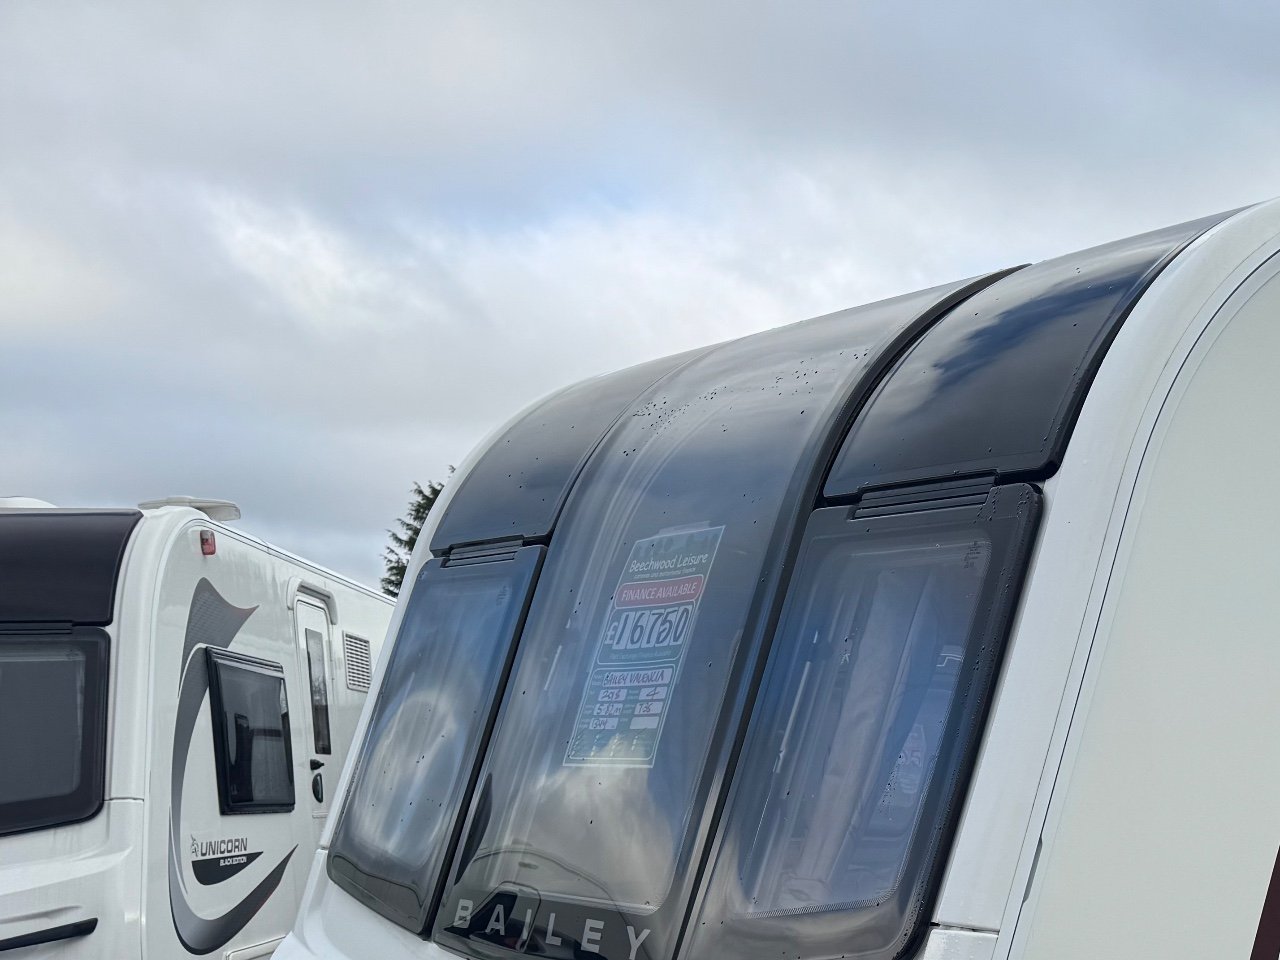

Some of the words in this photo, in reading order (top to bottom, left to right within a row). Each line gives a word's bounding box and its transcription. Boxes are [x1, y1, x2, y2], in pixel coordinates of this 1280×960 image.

[629, 554, 677, 573] Beechwood
[677, 553, 709, 567] Leisure
[622, 587, 656, 601] FINANCE
[656, 582, 697, 599] AVAILABLE
[604, 607, 690, 645] £16750
[200, 837, 248, 857] UNICORN
[220, 857, 232, 867] BLACK
[232, 856, 247, 865] EDITION
